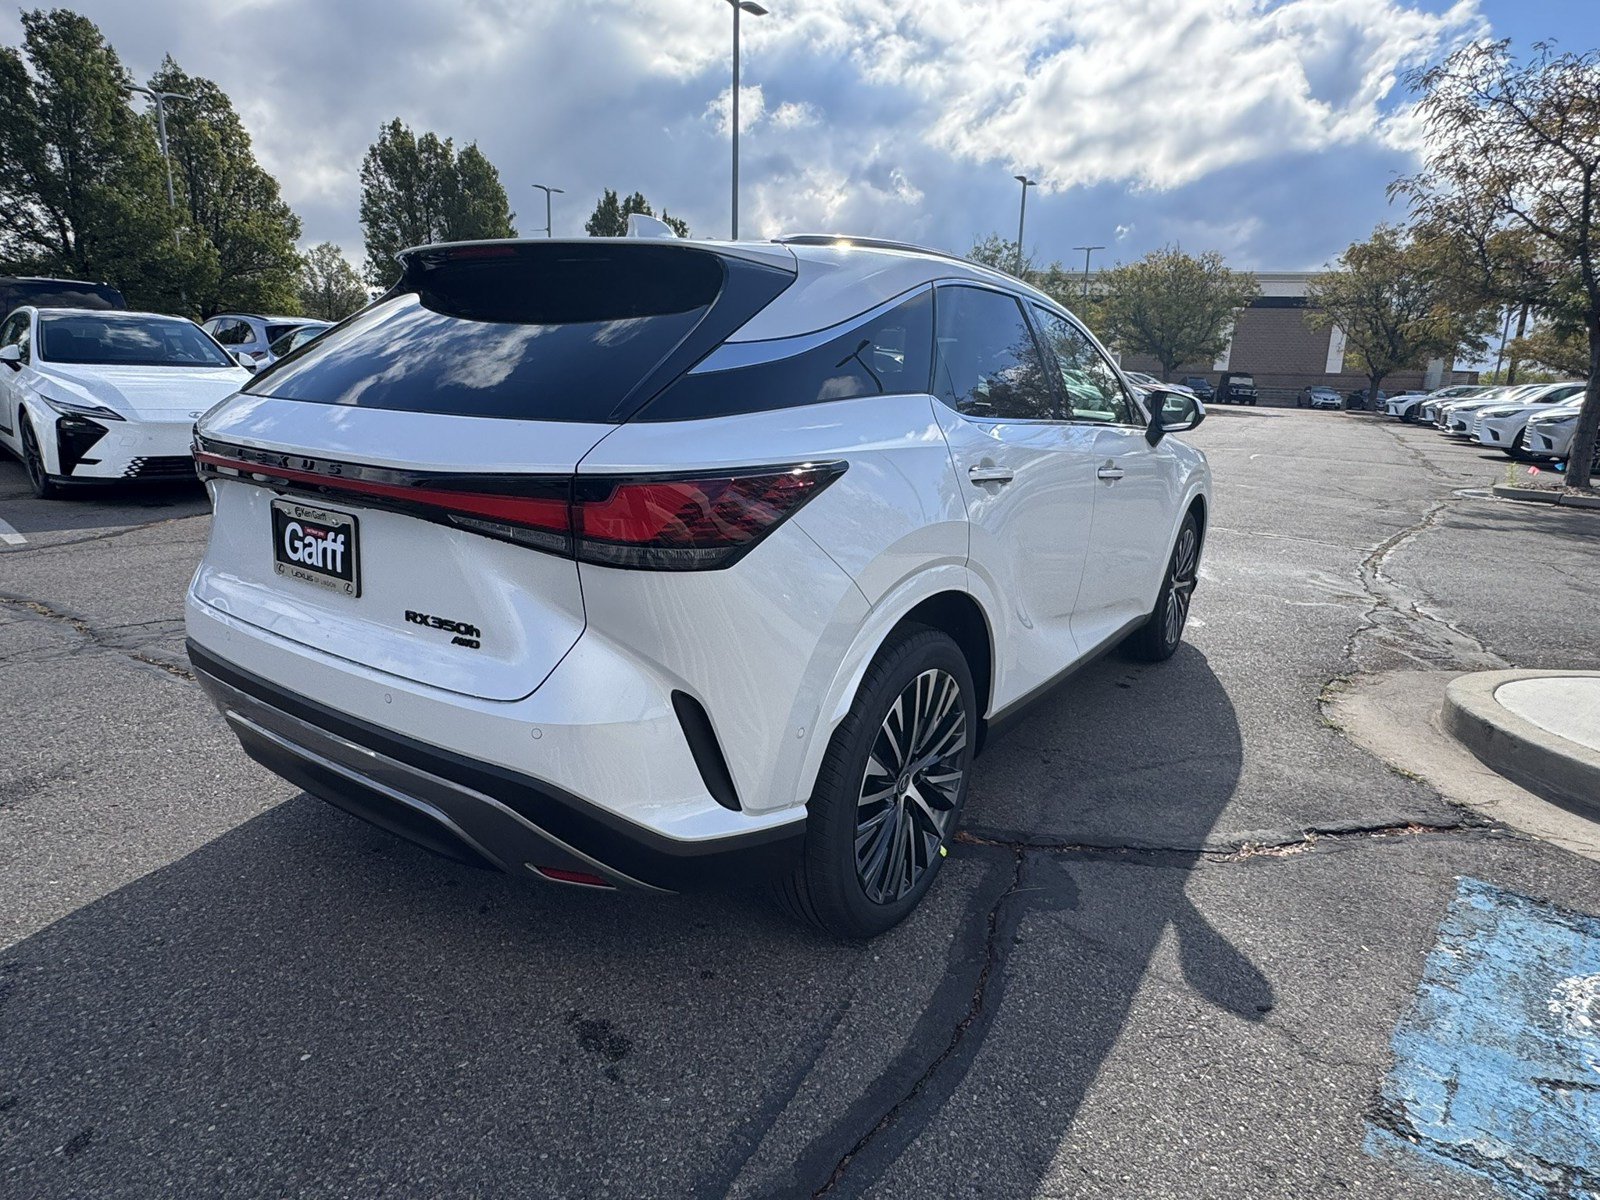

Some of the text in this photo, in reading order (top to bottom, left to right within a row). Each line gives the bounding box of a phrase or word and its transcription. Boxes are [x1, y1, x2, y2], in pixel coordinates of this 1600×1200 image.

[237, 448, 342, 475] LEXUS
[284, 521, 345, 573] Garff
[451, 636, 480, 650] AWD
